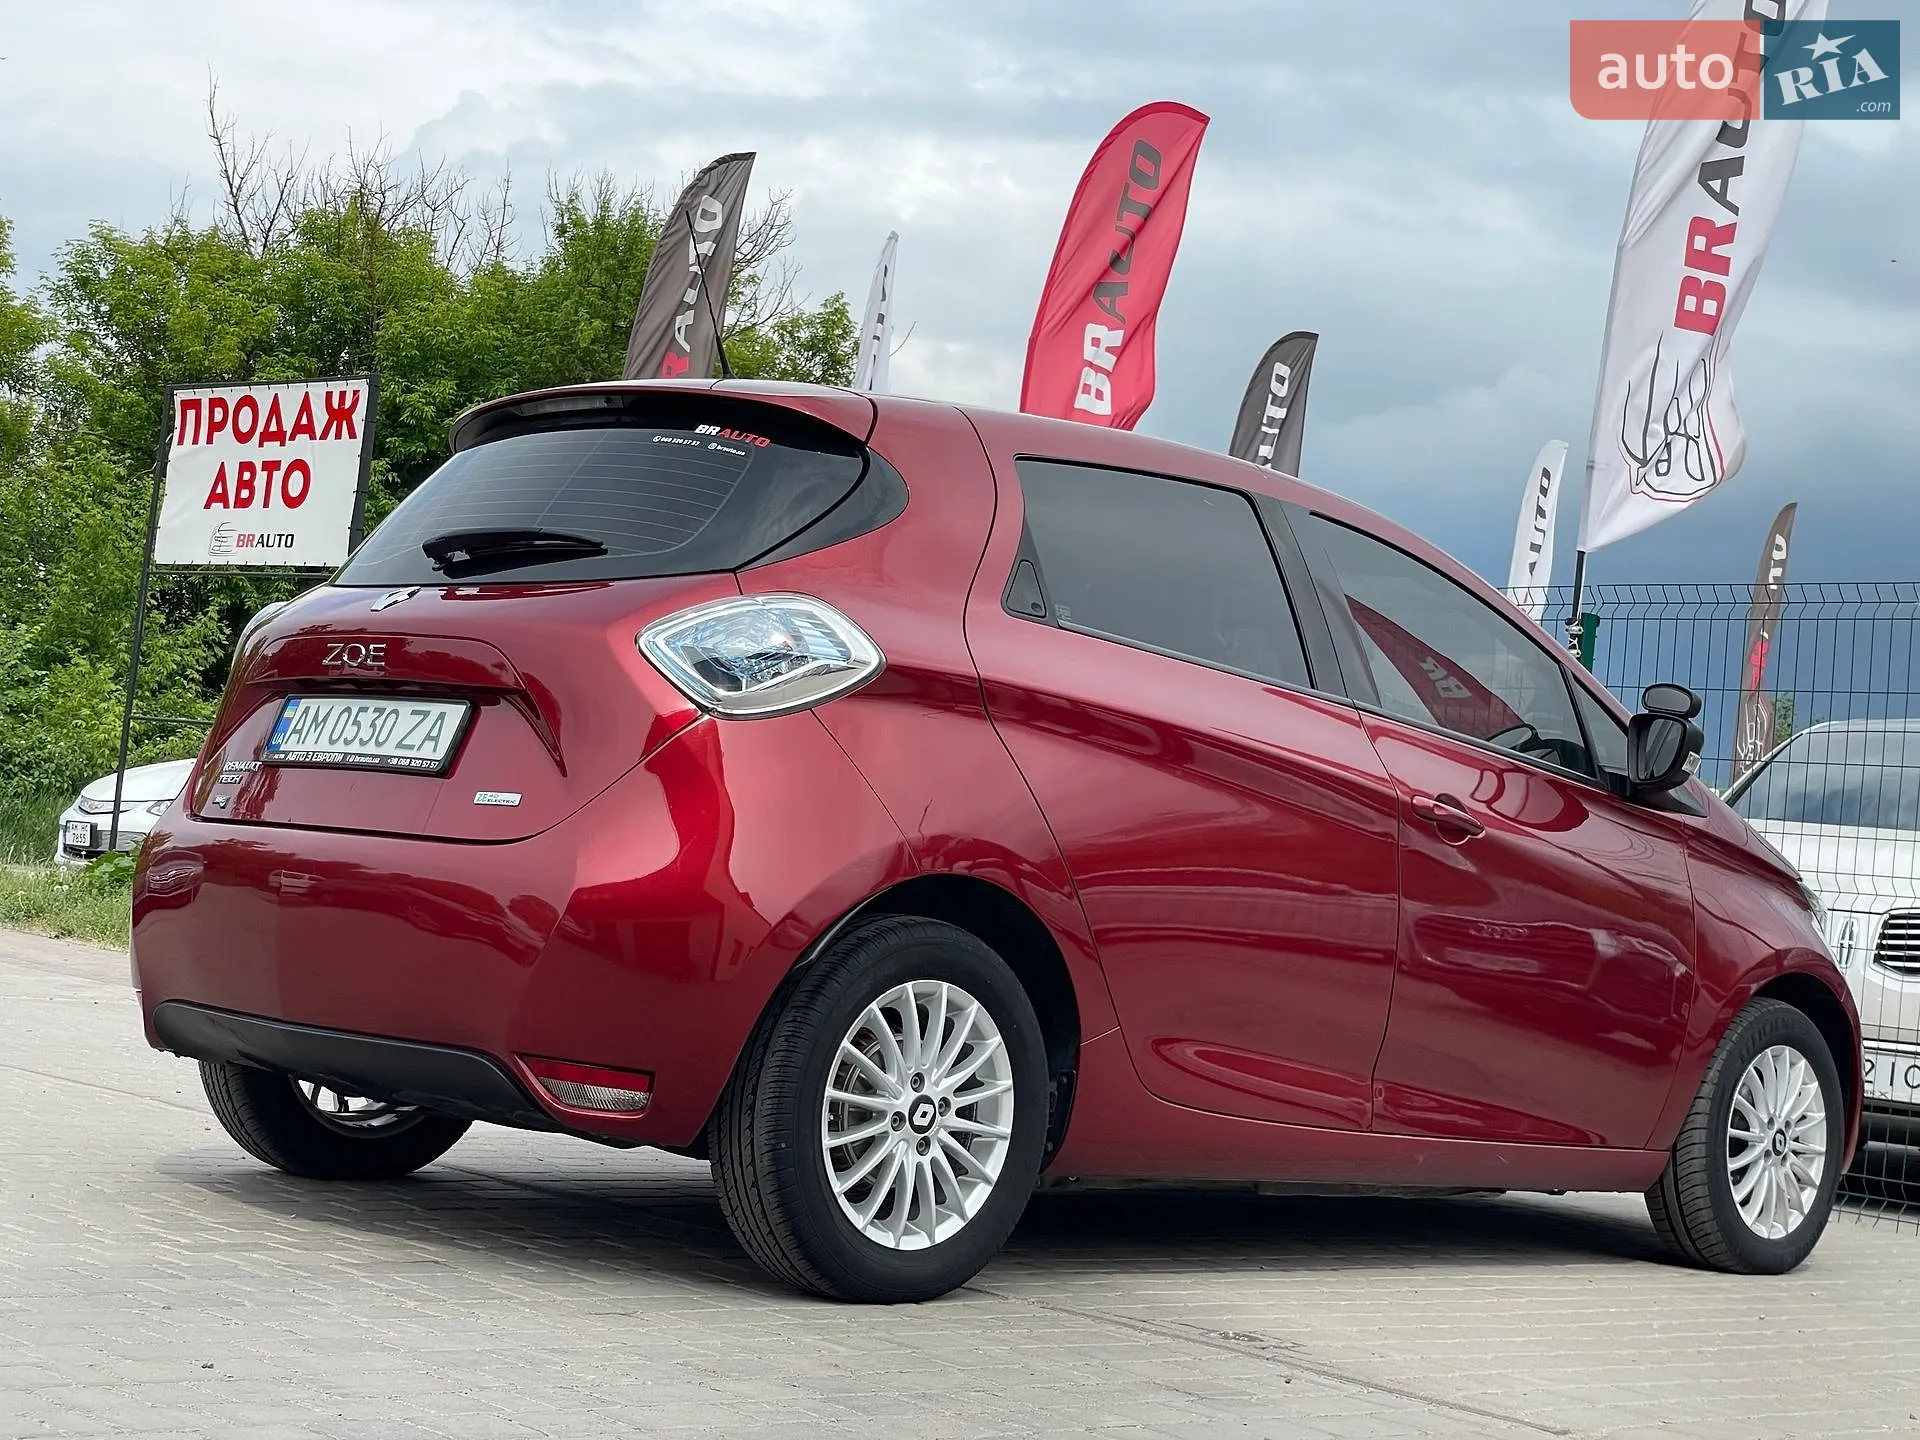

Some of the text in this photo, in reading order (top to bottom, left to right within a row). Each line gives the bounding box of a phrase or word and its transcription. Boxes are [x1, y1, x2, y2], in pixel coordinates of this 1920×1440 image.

[661, 194, 723, 379] RAUTO
[1074, 139, 1162, 416] BRAUTO
[176, 389, 361, 448] ПРОДАЖ
[694, 424, 771, 448] BRAUTO
[1258, 361, 1291, 468] UTO
[203, 457, 312, 510] АВТО
[236, 533, 295, 549] BRAUTO
[322, 643, 386, 666] ZOE
[272, 704, 447, 753] UA AM 0530 ZA
